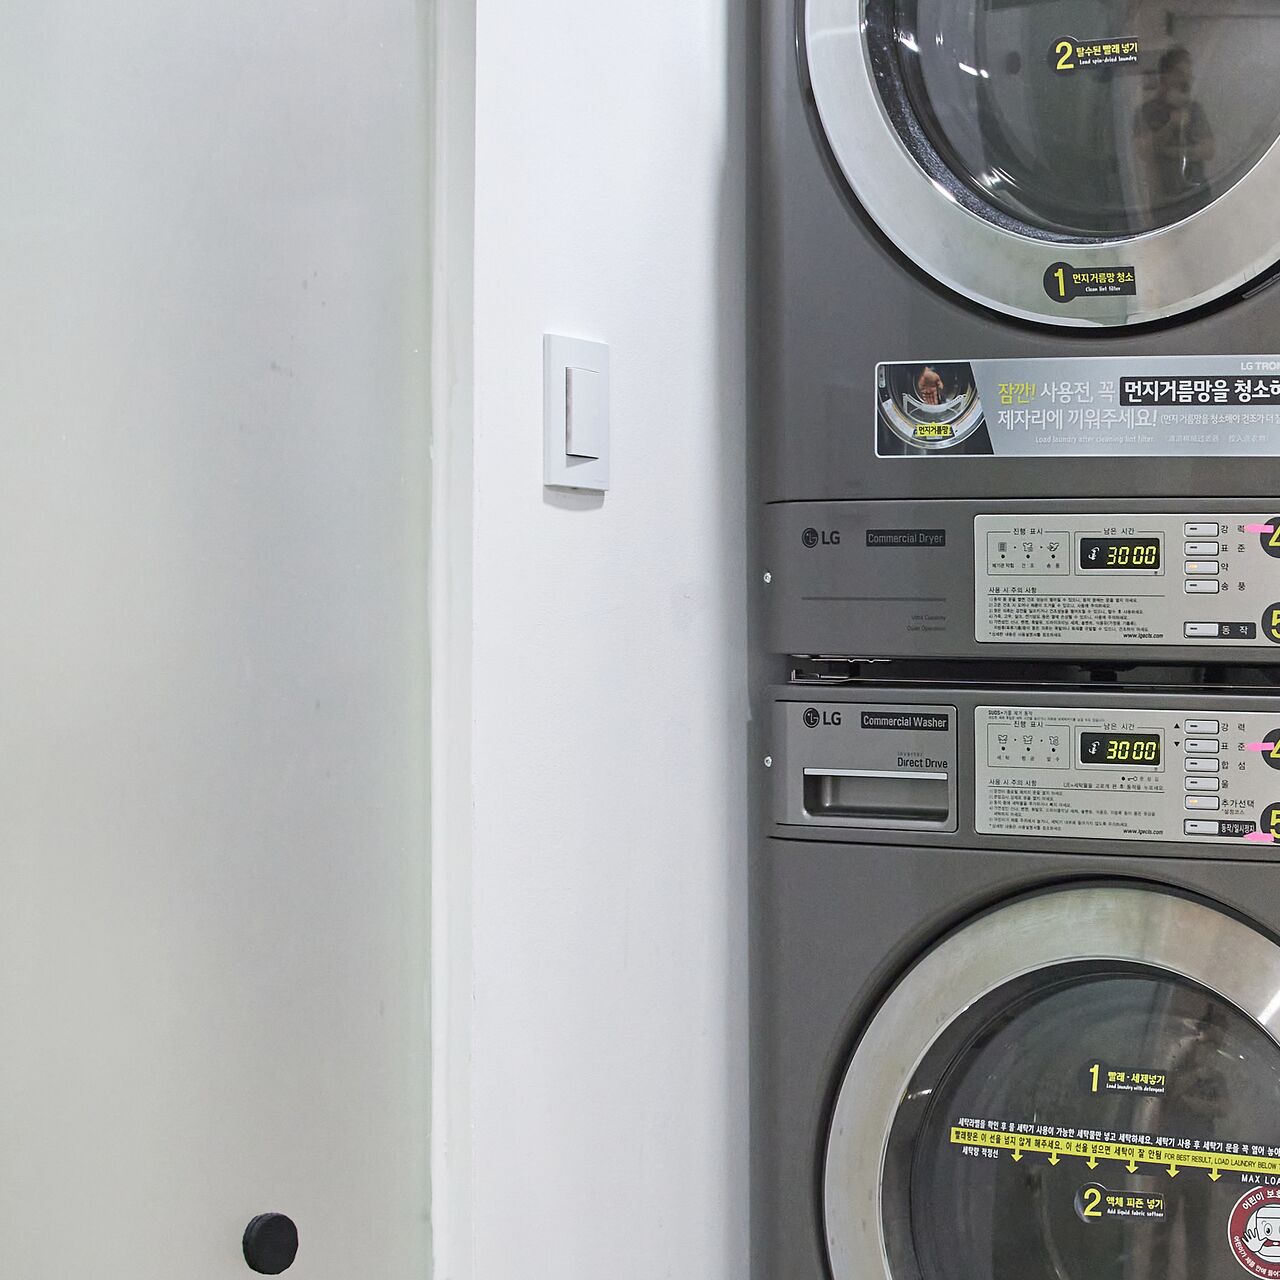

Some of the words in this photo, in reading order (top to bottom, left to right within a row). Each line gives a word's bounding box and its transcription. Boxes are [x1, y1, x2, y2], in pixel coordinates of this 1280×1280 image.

[1056, 42, 1074, 70] 2
[1076, 46, 1101, 57] 탈수된
[1103, 44, 1120, 55] 빨래
[1121, 43, 1137, 54] 넣기
[1054, 268, 1065, 296] 1
[1241, 362, 1253, 370] LG
[998, 382, 1036, 404] 잠깐!
[1098, 382, 1115, 402] 꼭
[1125, 380, 1229, 403] 먼지거름망을
[998, 409, 1063, 430] 제자리에
[1068, 409, 1157, 430] 끼워주세요!
[822, 531, 840, 545] LG
[868, 533, 916, 543] Commercial
[920, 533, 943, 545] Dryer
[823, 712, 841, 725] LG
[864, 716, 911, 726] Commercial
[913, 717, 946, 727] Washer
[898, 757, 923, 767] Direct
[926, 758, 947, 768] Drive
[1221, 799, 1255, 809] 추가선택
[1090, 1064, 1099, 1092] 1
[1231, 1159, 1255, 1167] LAUNDRY
[1241, 1174, 1260, 1183] MAX
[1084, 1188, 1102, 1216] 2
[1147, 1199, 1163, 1209] 넣기
[1242, 1192, 1264, 1210] 어린이
